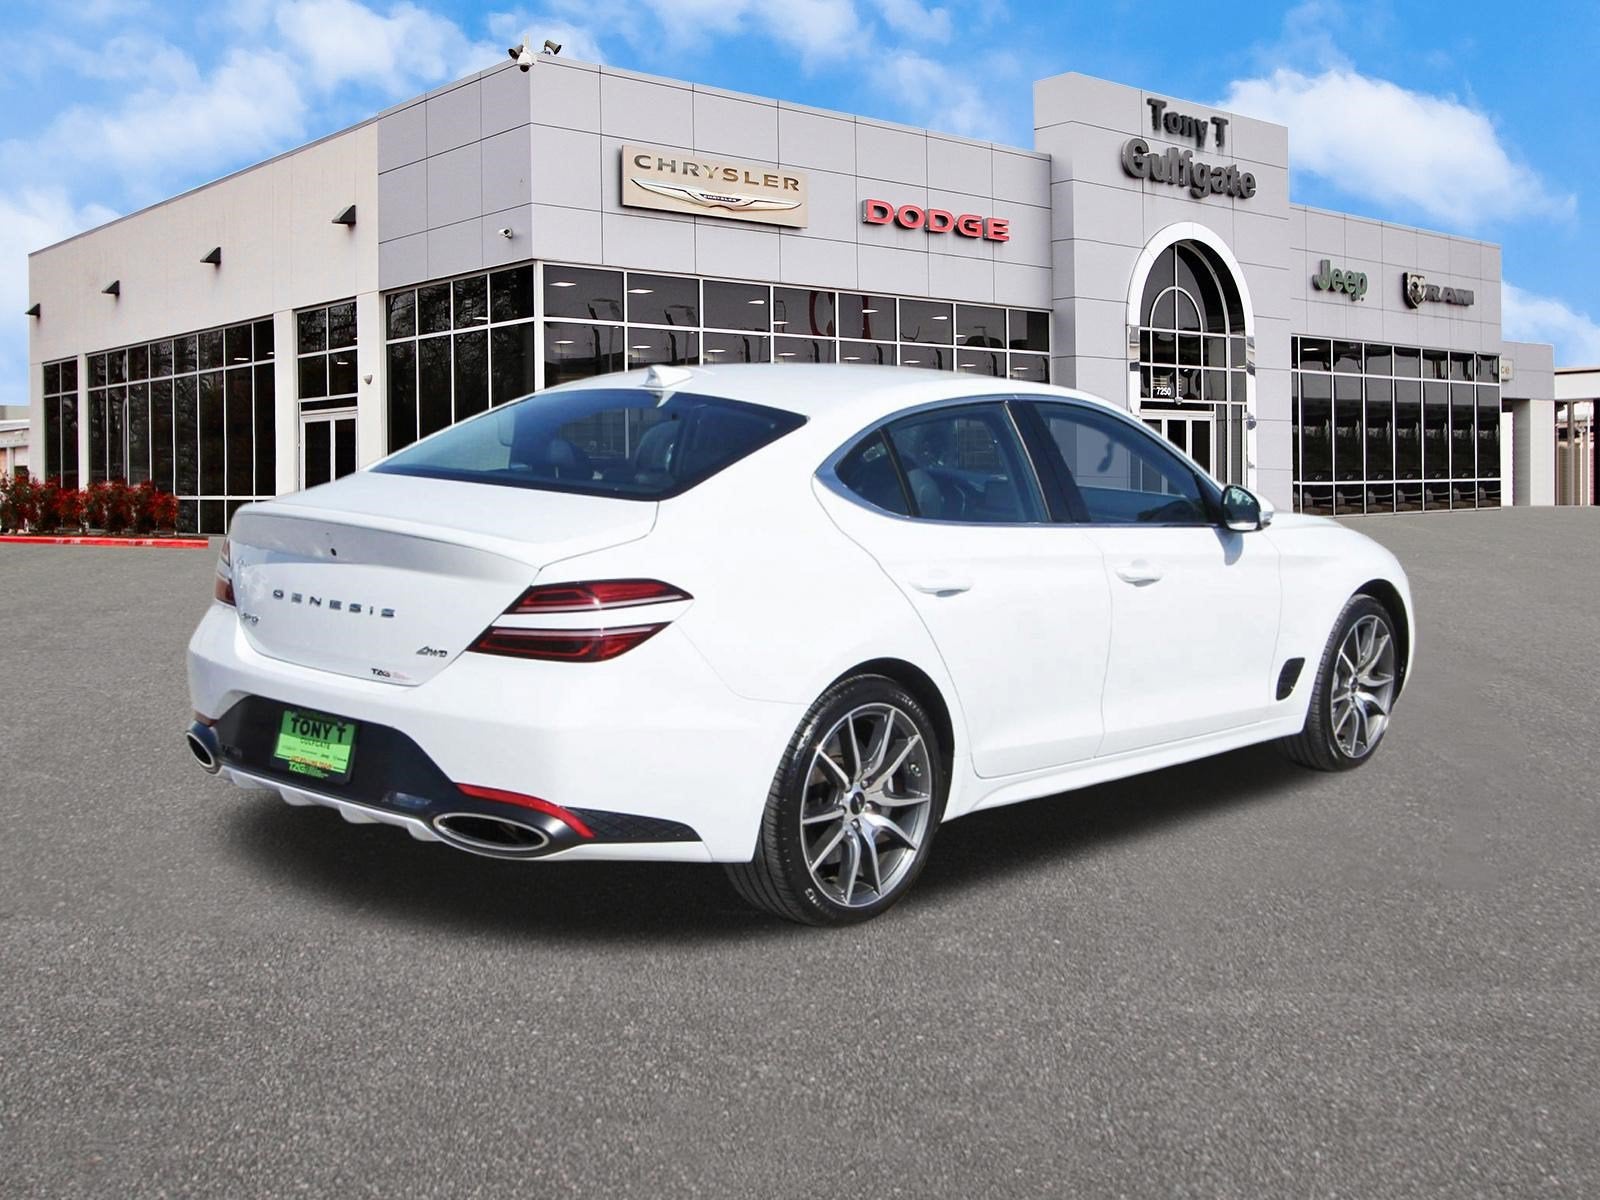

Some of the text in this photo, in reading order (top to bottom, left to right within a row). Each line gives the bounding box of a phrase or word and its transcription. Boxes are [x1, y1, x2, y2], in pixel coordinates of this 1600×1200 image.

[1147, 98, 1229, 147] Tony T
[633, 154, 800, 192] CHRYSLER
[1121, 138, 1256, 199] Gulfgate
[862, 198, 1010, 243] DODGE
[1311, 259, 1368, 303] Jeep
[1424, 283, 1475, 307] RAM
[272, 588, 396, 619] GENESIS
[291, 716, 347, 744] TONY T
